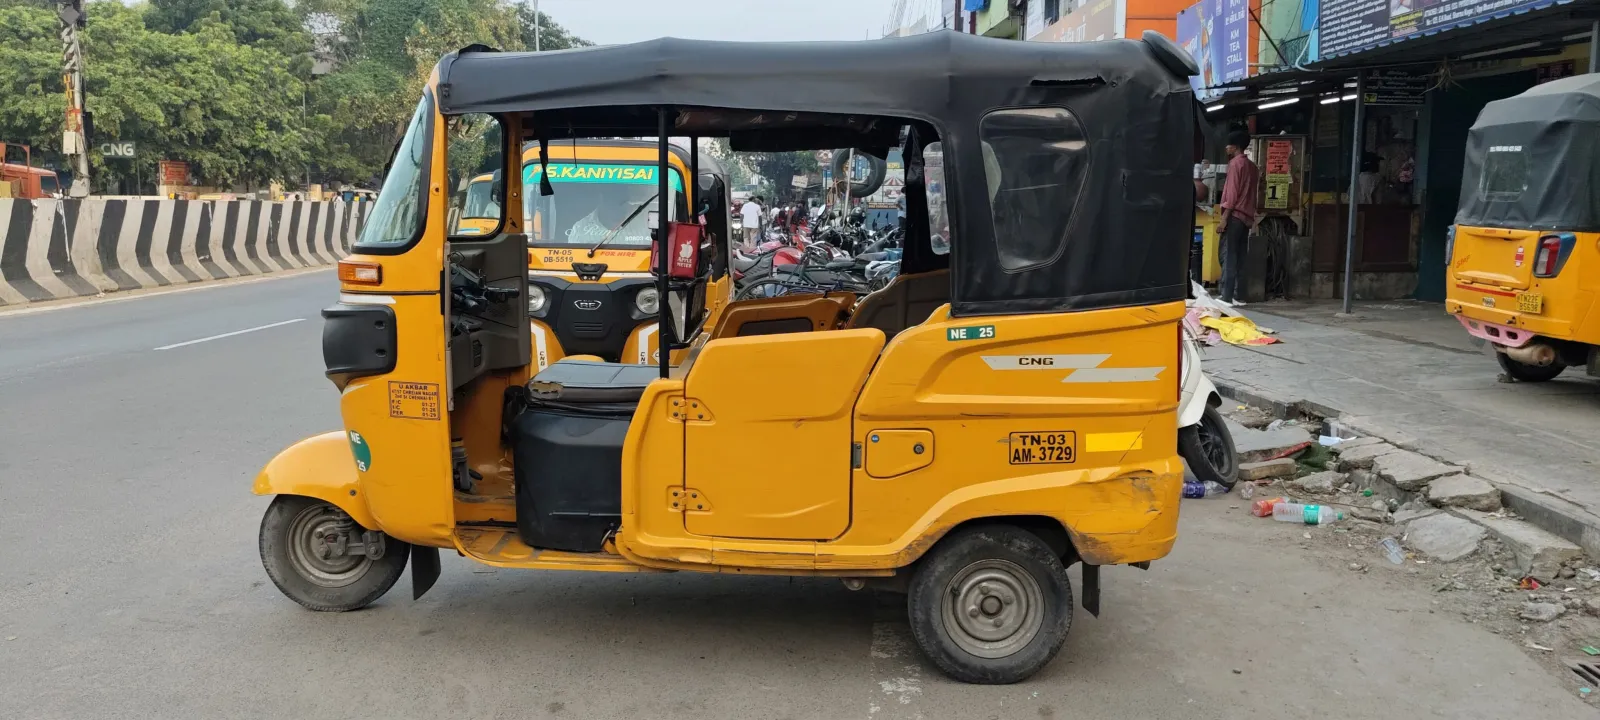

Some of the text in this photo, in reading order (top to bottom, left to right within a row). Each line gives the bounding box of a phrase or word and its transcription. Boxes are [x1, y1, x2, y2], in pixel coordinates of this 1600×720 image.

[1230, 29, 1240, 40] KM
[1229, 41, 1240, 52] TEA
[1226, 52, 1243, 65] STALL
[101, 143, 134, 156] CNG
[951, 327, 993, 339] NE 25
[1018, 357, 1054, 365] CNG
[350, 431, 361, 444] NE
[1019, 434, 1066, 446] TN-03
[1038, 446, 1072, 461] 3729
